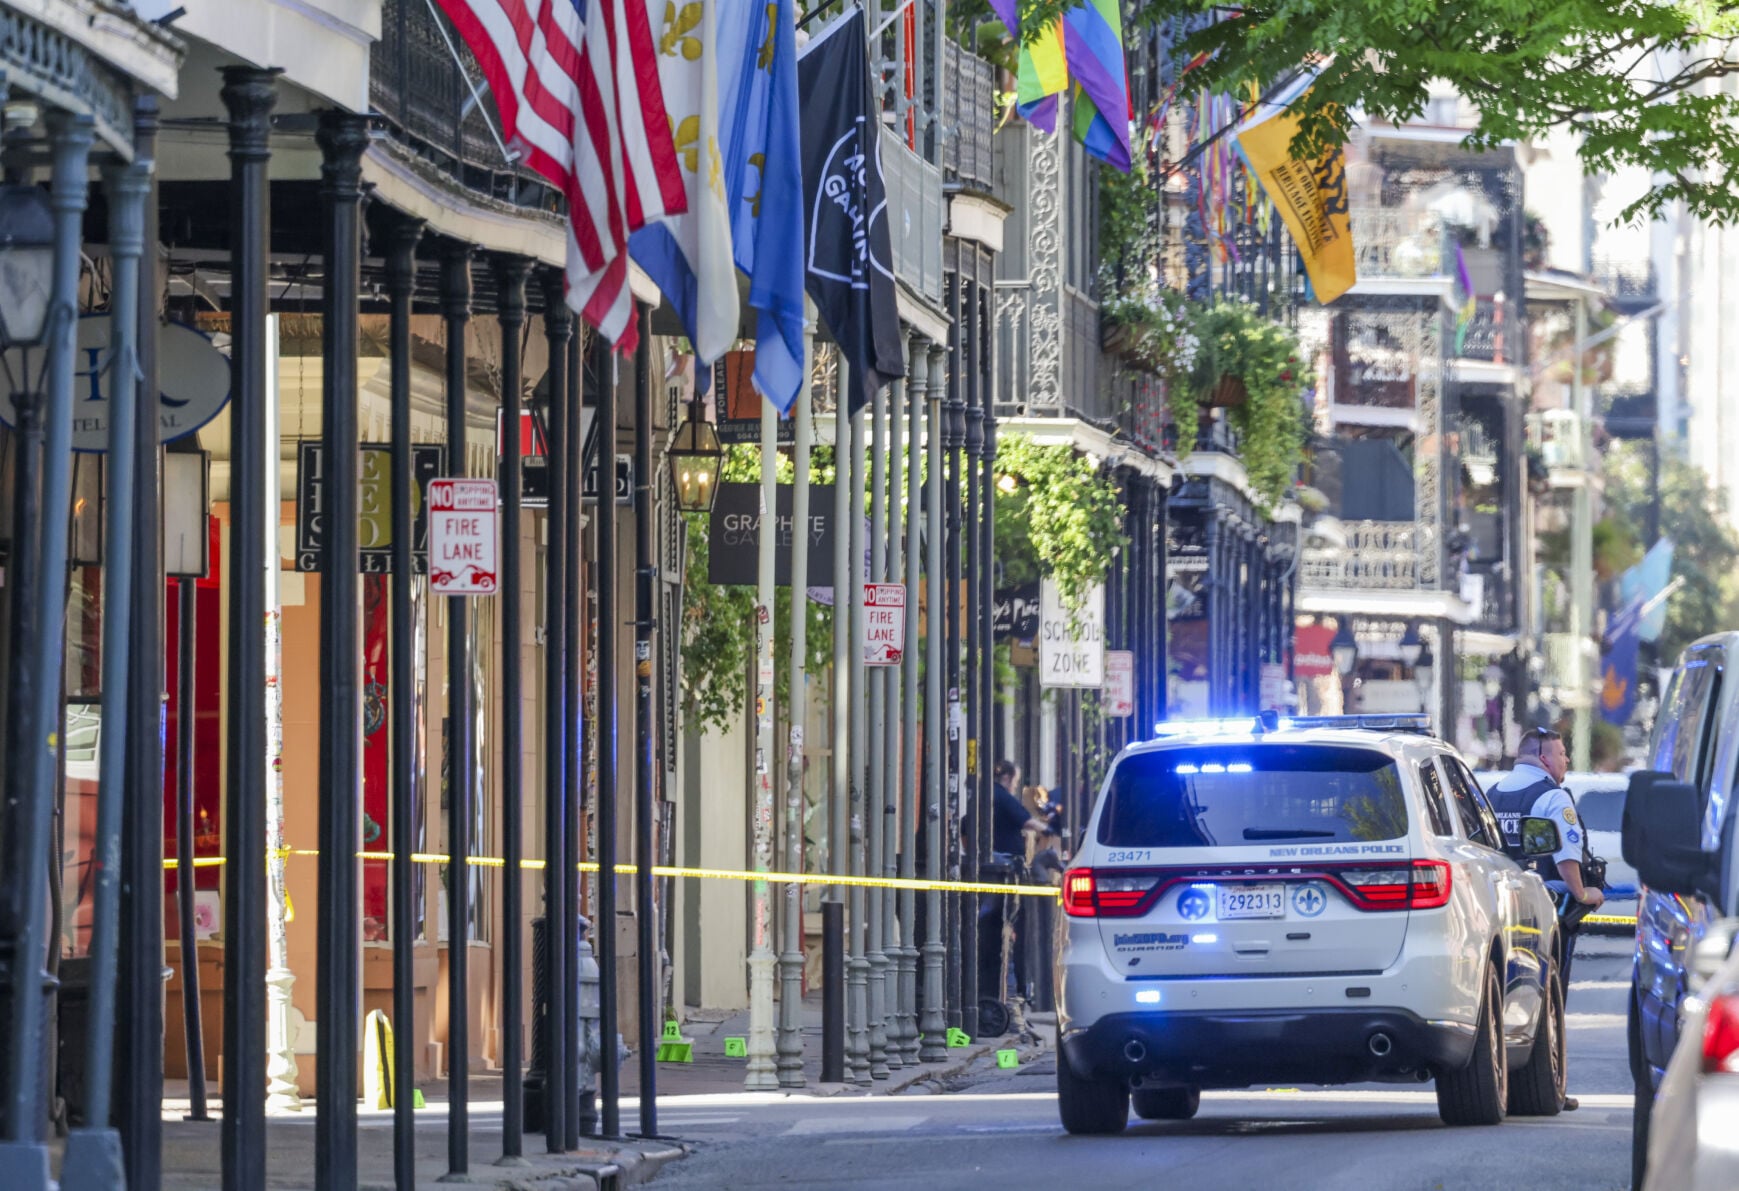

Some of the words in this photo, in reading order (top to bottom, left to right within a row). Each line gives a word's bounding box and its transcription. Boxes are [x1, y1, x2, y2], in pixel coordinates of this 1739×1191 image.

[431, 485, 453, 507] NO
[446, 518, 480, 536] FIRE
[443, 543, 483, 560] LANE
[869, 610, 893, 624] FIRE
[867, 628, 895, 641] LANE
[1053, 653, 1090, 673] ZONE
[1108, 851, 1151, 863] 23471
[1269, 848, 1298, 857] NEW
[1300, 846, 1359, 856] ORLEANS
[1361, 844, 1404, 854] POLICE
[1229, 893, 1281, 911] 292313
[666, 1026, 677, 1036] 12
